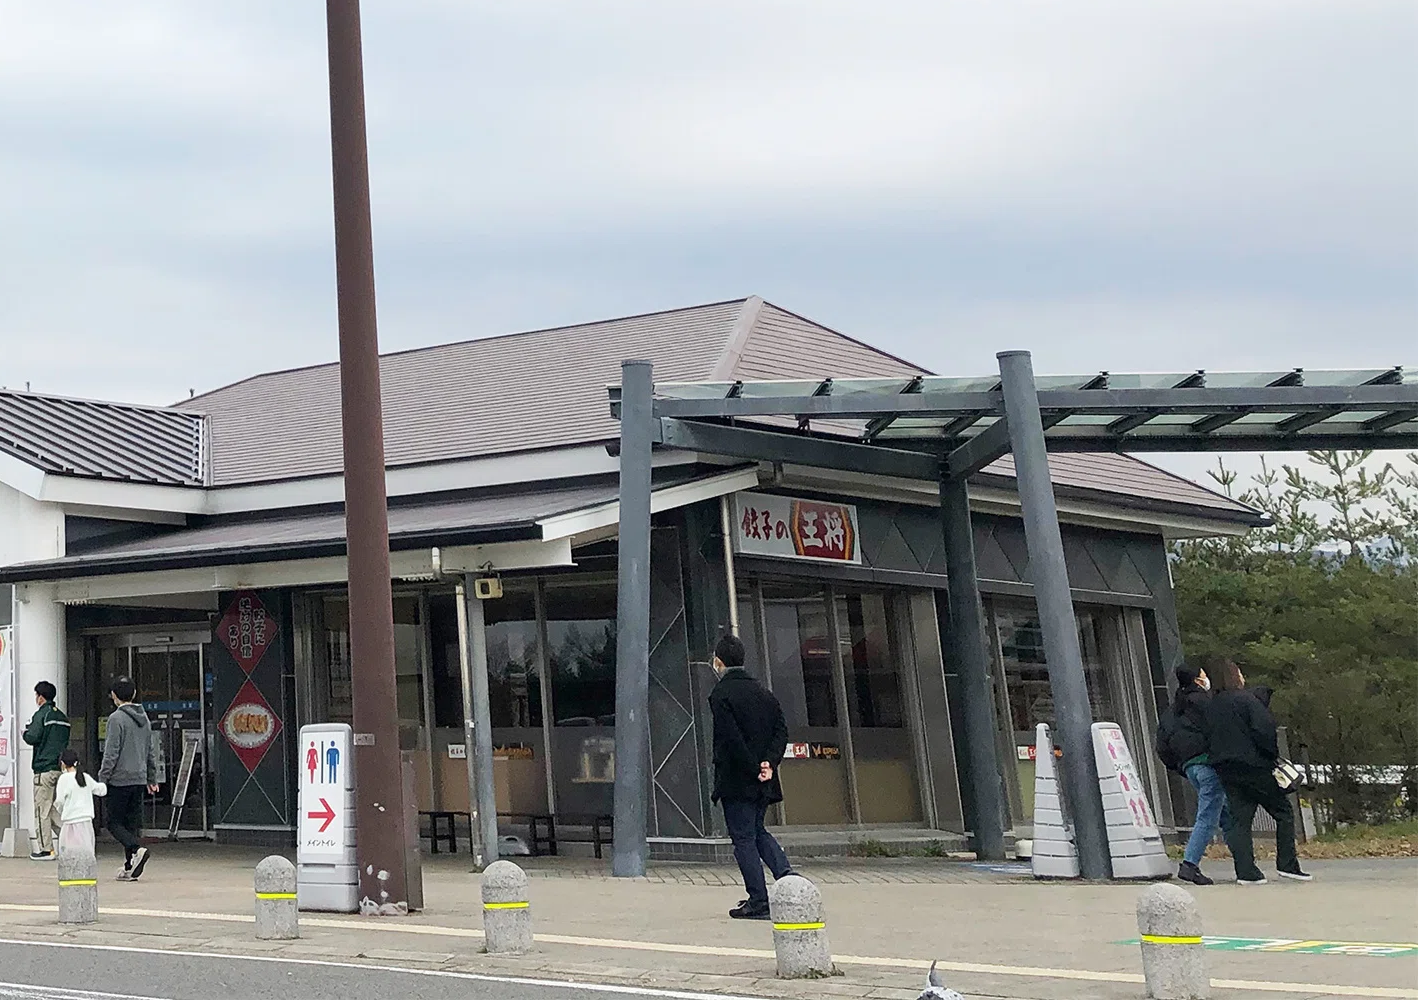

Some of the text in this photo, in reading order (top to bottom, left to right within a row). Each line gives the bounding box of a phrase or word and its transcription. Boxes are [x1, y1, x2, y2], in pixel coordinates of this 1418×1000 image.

[742, 506, 844, 552] 餃子の王将
[306, 839, 336, 847] メイントイレ
